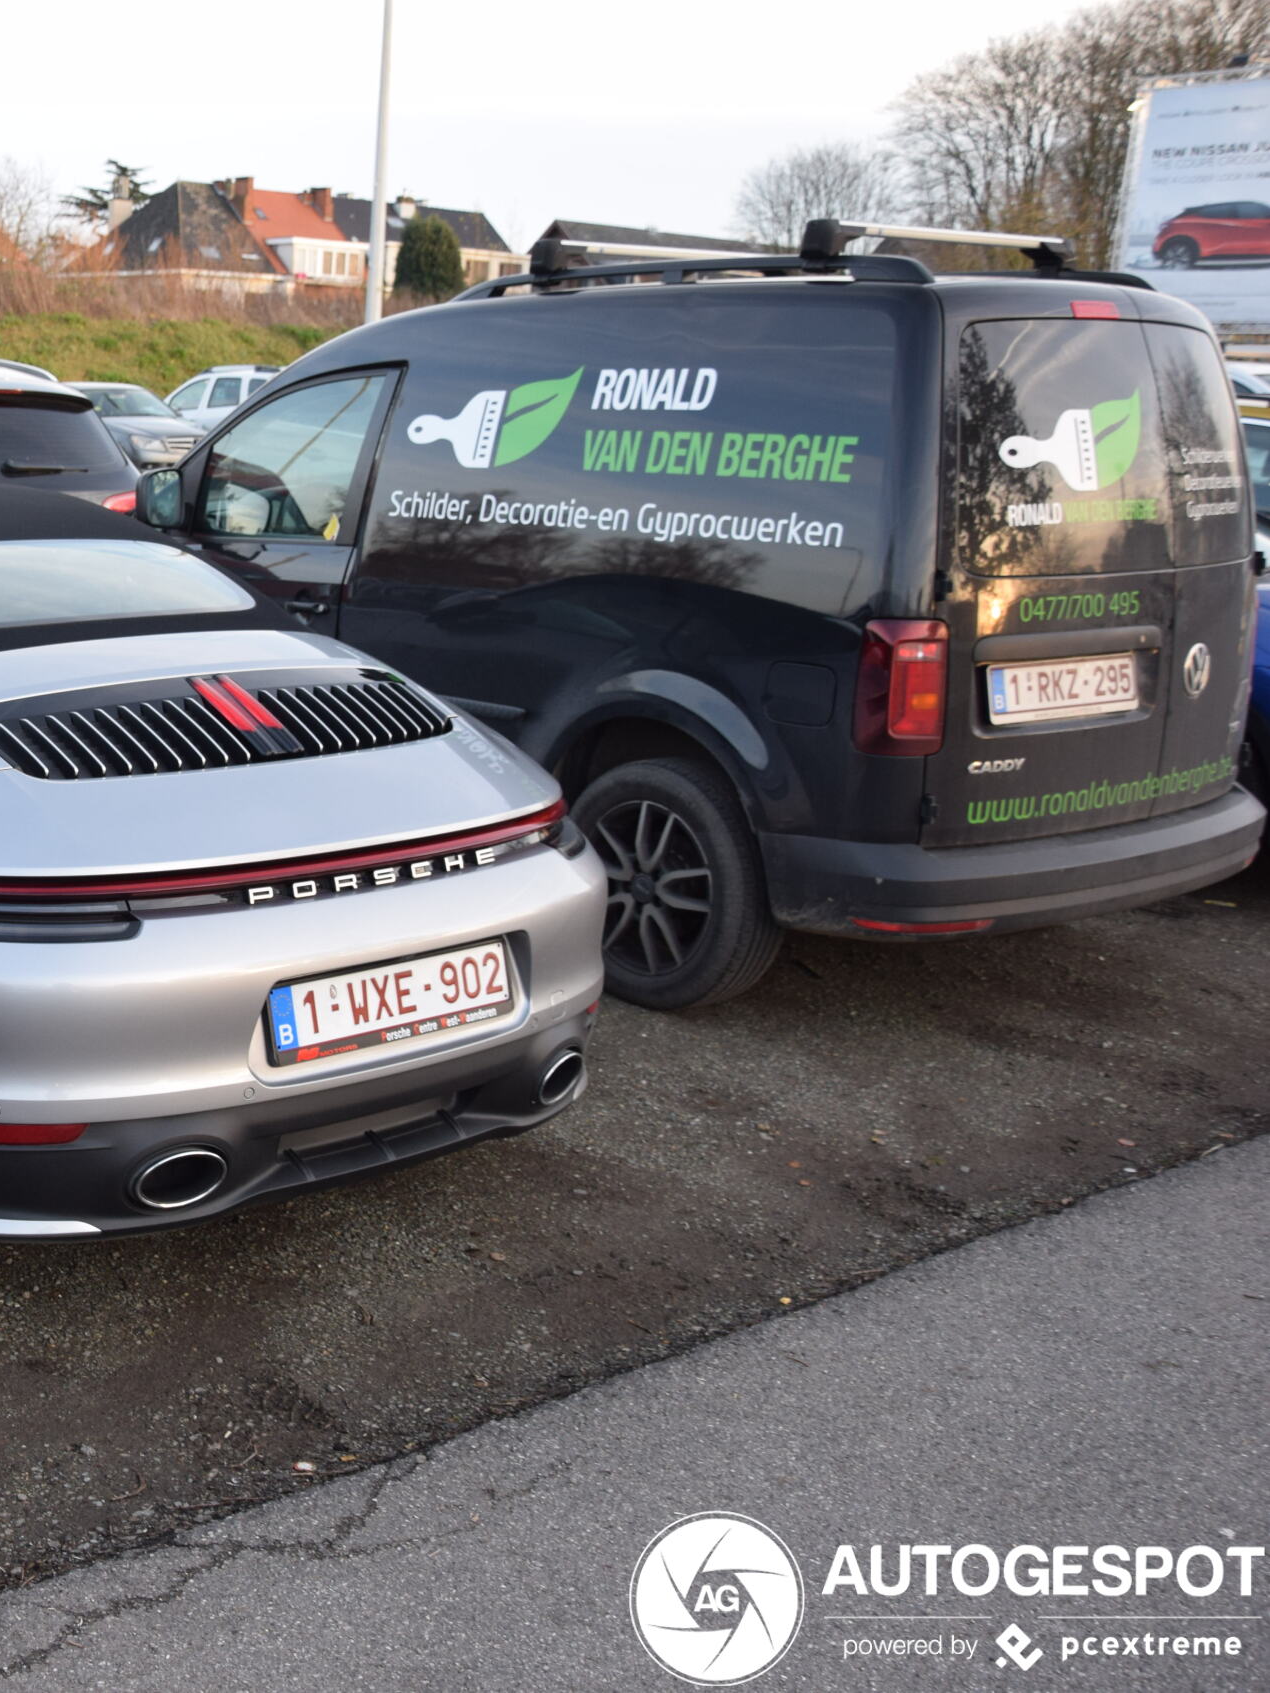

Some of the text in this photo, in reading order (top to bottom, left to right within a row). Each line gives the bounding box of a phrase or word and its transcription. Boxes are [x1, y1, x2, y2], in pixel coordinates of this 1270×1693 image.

[1190, 144, 1250, 156] NISSAN
[591, 367, 718, 411] RONALD
[583, 430, 859, 483] VAN DEN BERGHE
[389, 490, 844, 547] Schilder, Decoratie-en Gyprocwerken
[1007, 503, 1064, 527] RONALD
[1020, 590, 1140, 622] 0477/700 495
[967, 757, 1026, 774] CADDY
[967, 755, 1233, 824] www.ronaldvandenberghe.be
[248, 848, 496, 904] PORSCHE
[278, 951, 504, 1046] B 1-WXE-902
[320, 1043, 358, 1057] MOTORS
[381, 1027, 411, 1043] Porsche
[414, 1021, 438, 1036] Centre
